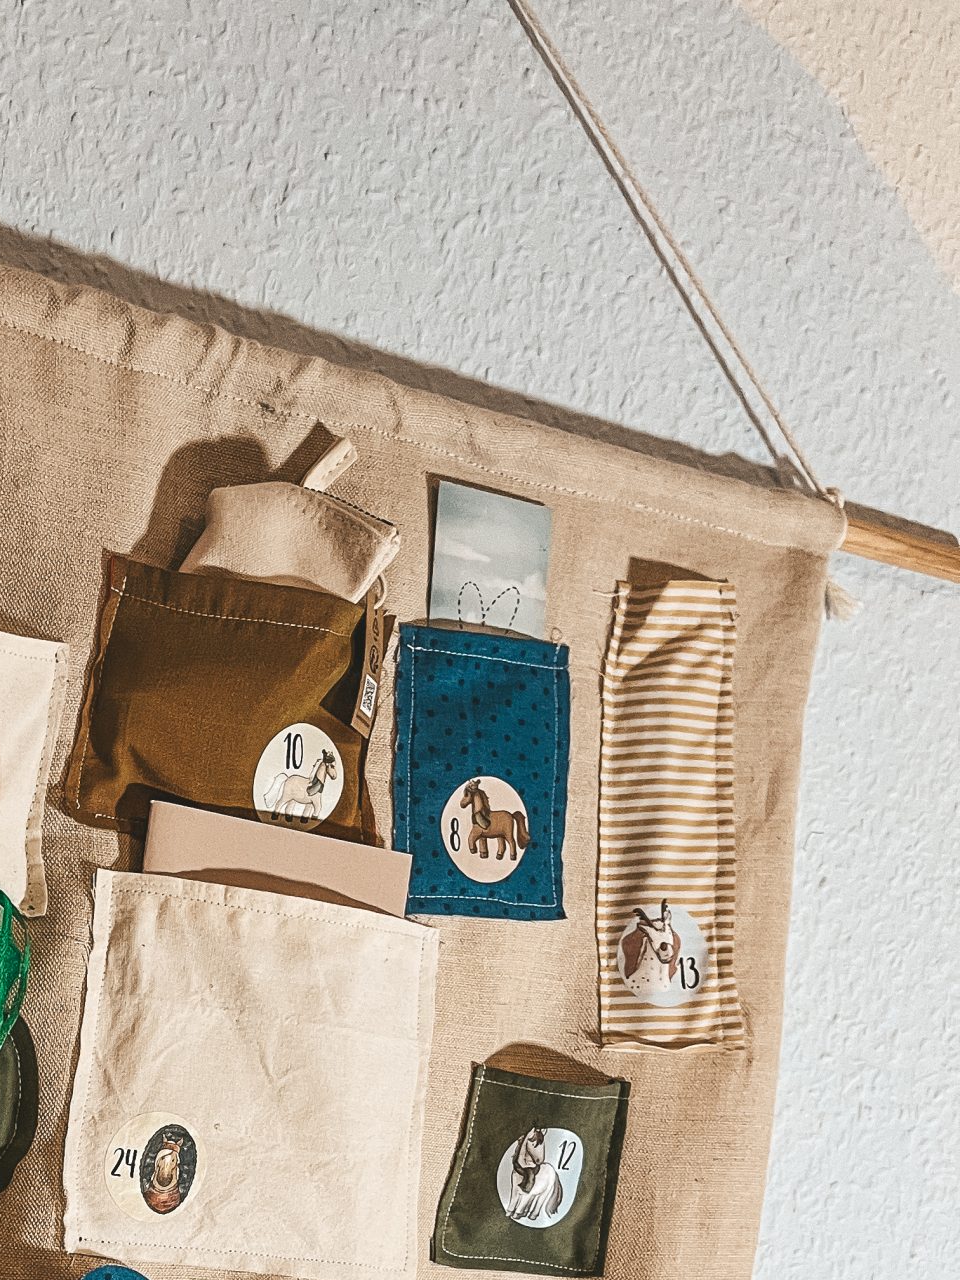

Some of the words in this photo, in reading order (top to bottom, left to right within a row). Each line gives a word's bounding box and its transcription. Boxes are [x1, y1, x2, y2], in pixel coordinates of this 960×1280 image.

[284, 733, 303, 769] 10
[450, 818, 460, 851] 8
[679, 958, 699, 989] 13
[111, 1148, 137, 1178] 24
[557, 1140, 577, 1171] 12
